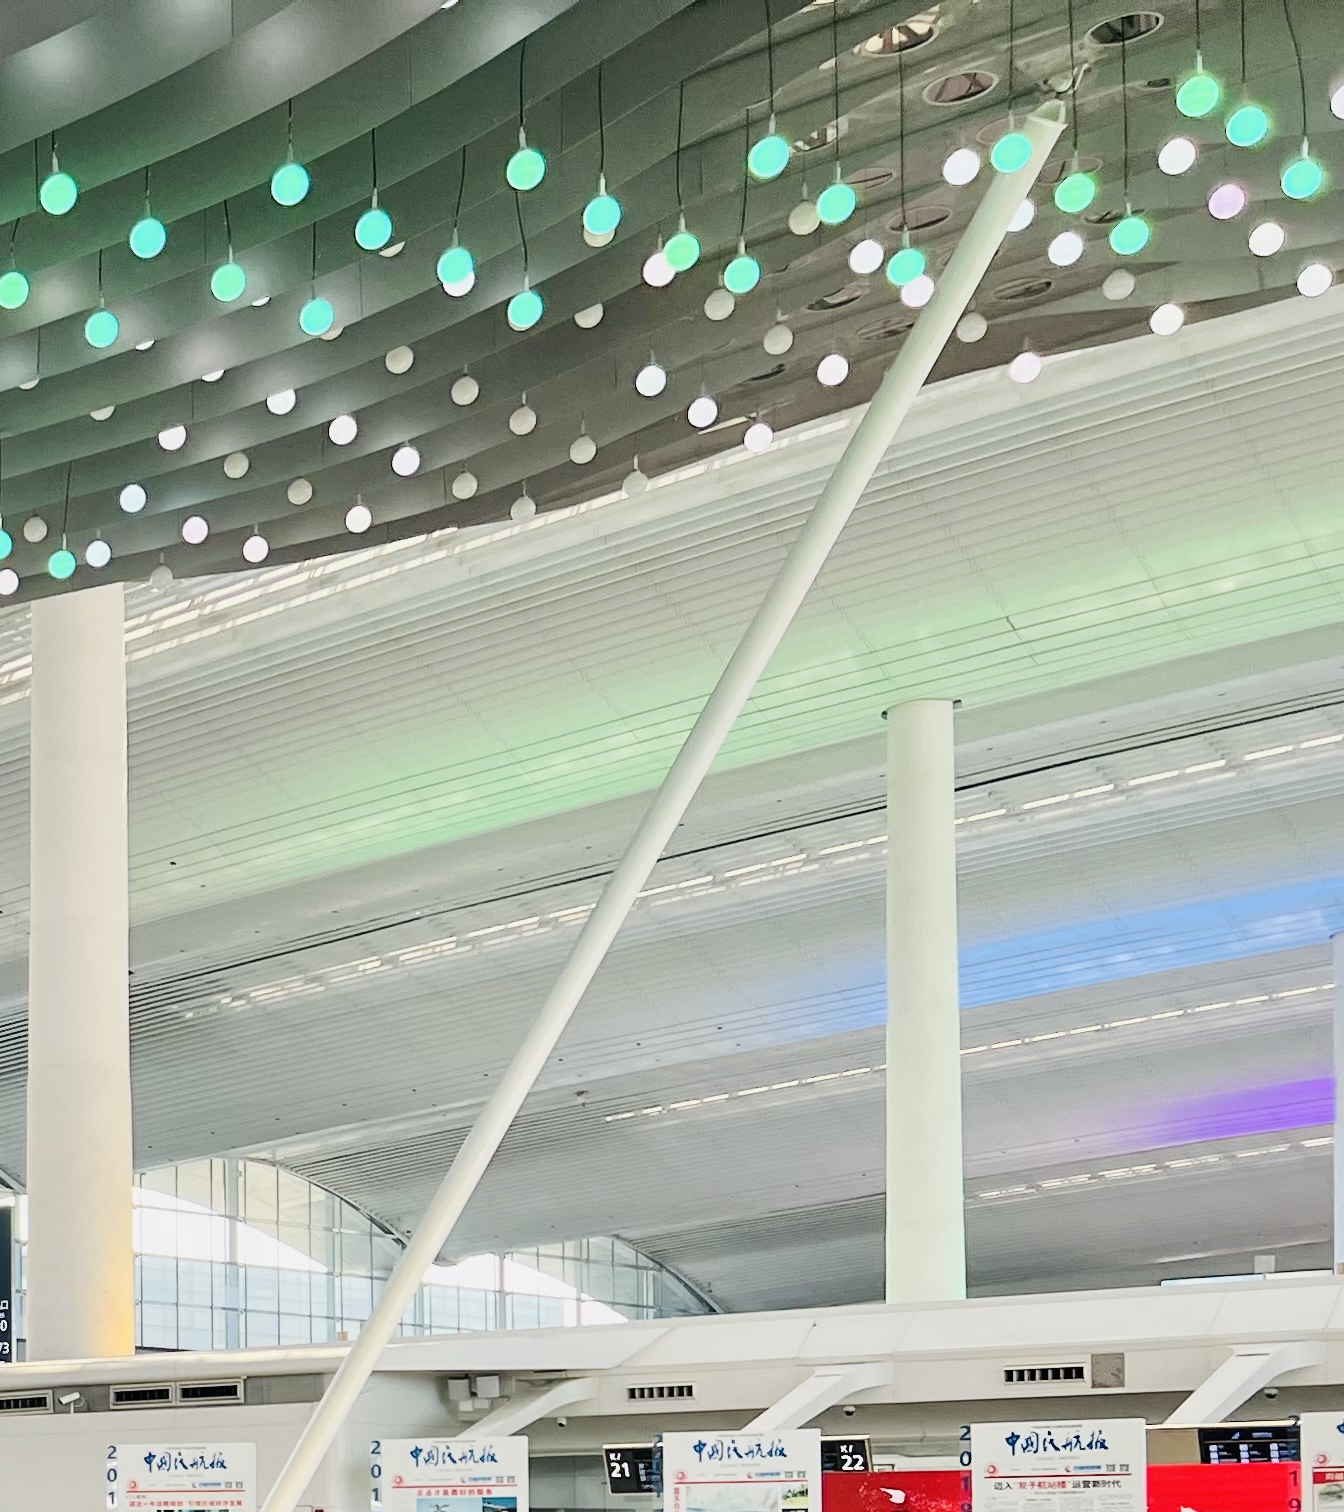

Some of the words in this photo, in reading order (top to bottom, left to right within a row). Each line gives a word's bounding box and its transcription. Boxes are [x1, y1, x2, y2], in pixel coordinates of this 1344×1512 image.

[692, 1438, 788, 1463] 中国民航报
[1005, 1429, 1110, 1457] 中国民航报
[144, 1451, 228, 1474] 中国民航报
[409, 1444, 500, 1468] 中国民航报
[841, 1454, 865, 1471] 22
[611, 1462, 631, 1478] 21
